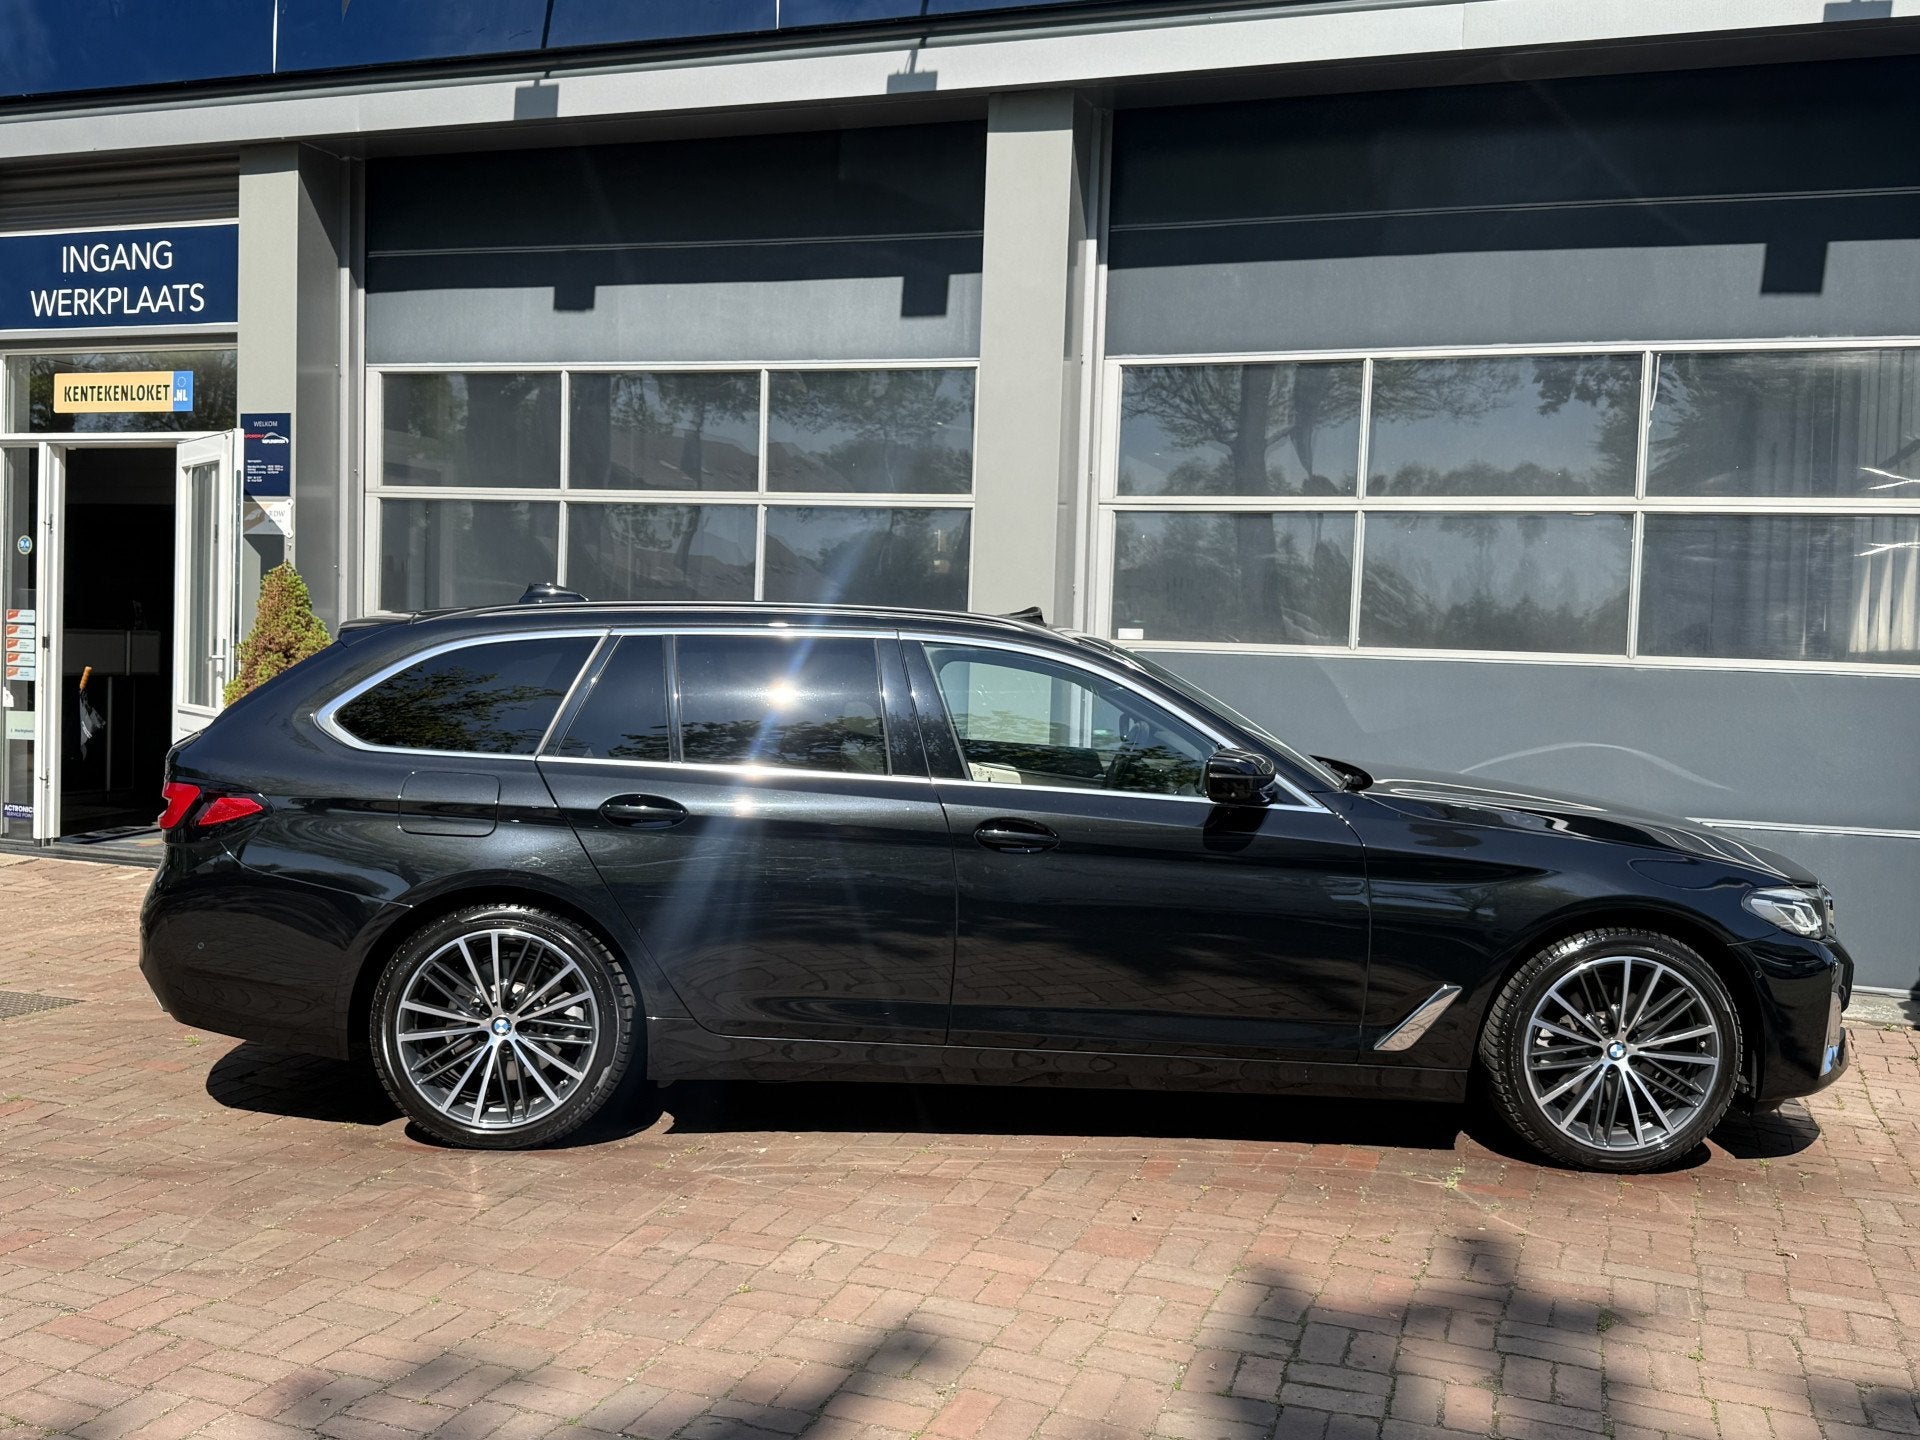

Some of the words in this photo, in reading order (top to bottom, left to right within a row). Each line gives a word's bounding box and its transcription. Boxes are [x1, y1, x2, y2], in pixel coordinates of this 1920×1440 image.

[62, 240, 173, 273] INGANG
[30, 282, 205, 317] WERKPLAATS
[64, 384, 170, 402] KENTEKENLOKET
